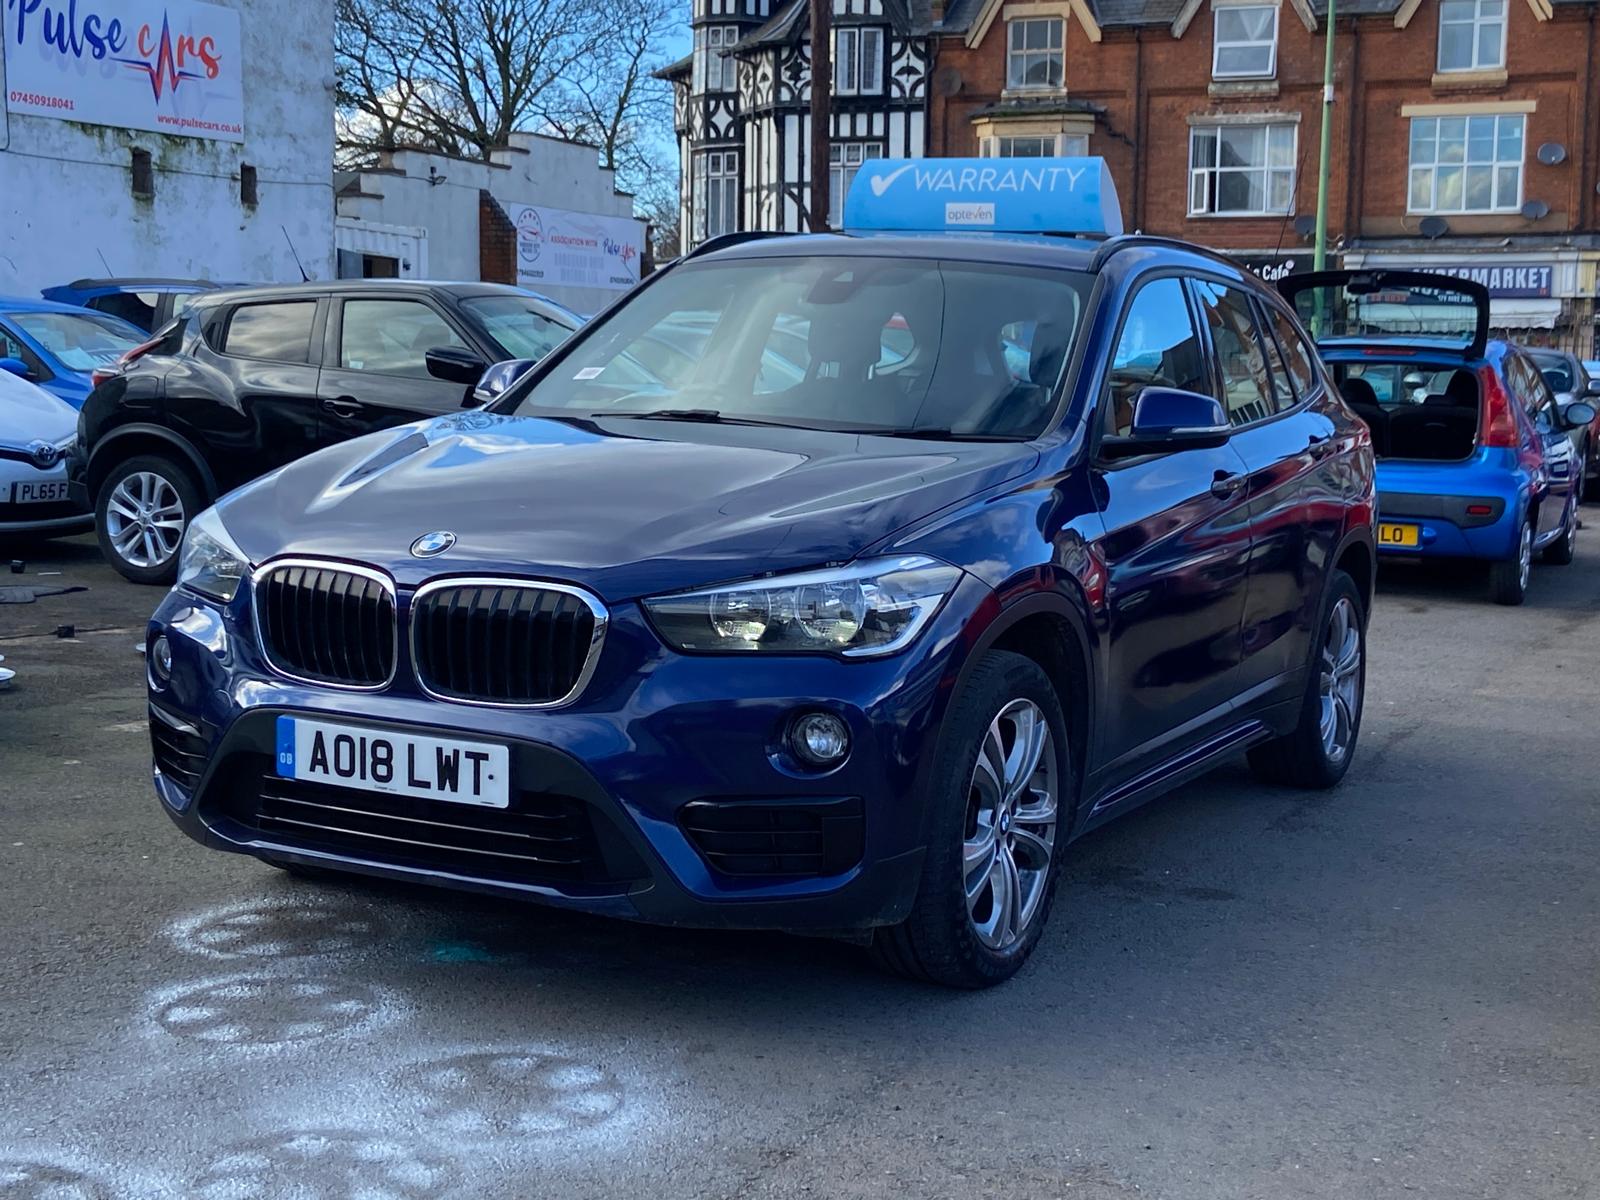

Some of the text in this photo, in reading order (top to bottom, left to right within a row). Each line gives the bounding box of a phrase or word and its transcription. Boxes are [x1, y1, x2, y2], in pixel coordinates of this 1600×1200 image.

[8, 0, 127, 60] Pulse
[10, 91, 75, 110] 07450918041
[157, 114, 242, 134] www.pulsecars.co.uk
[914, 167, 1086, 192] WARRANTY
[948, 206, 993, 221] opteven
[22, 484, 56, 500] PL65
[279, 752, 293, 764] GB
[309, 730, 489, 796] AO18 LWT
